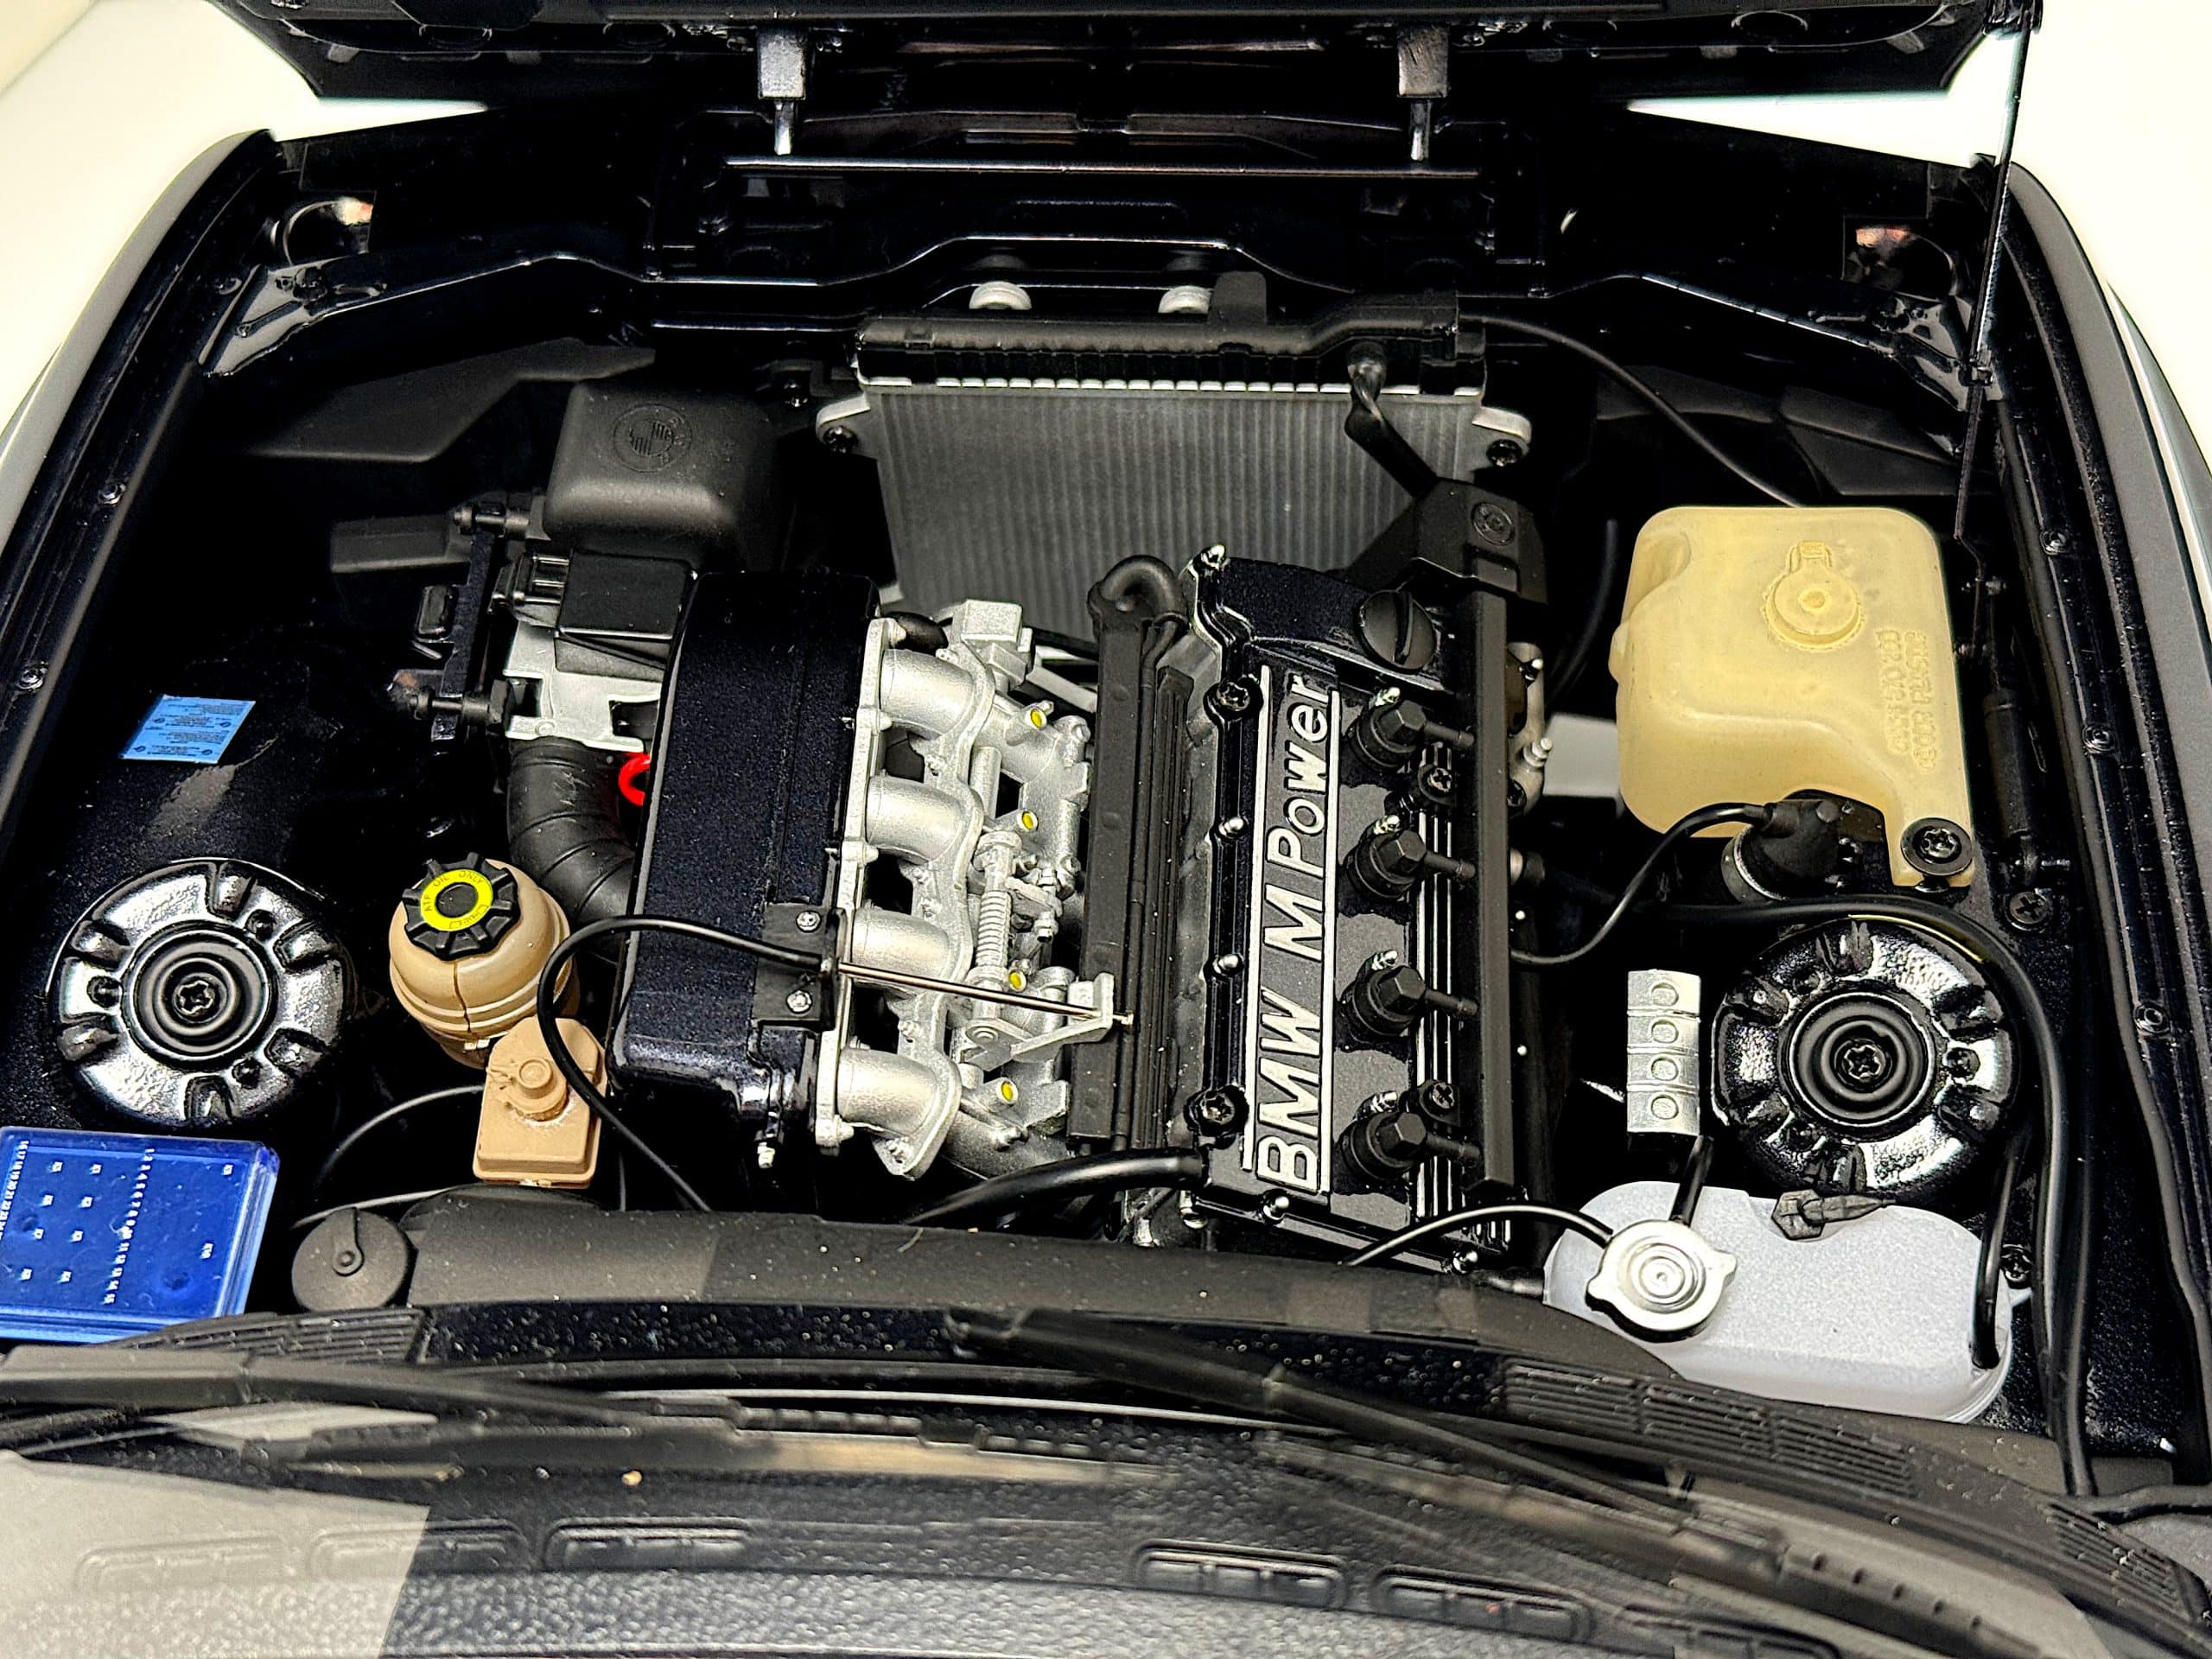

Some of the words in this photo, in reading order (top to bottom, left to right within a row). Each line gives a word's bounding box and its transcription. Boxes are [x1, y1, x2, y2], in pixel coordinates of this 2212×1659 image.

[423, 894, 432, 912] ATF
[433, 876, 450, 887] OIL
[457, 870, 484, 884] ONLY
[1257, 986, 1321, 1194] BMW
